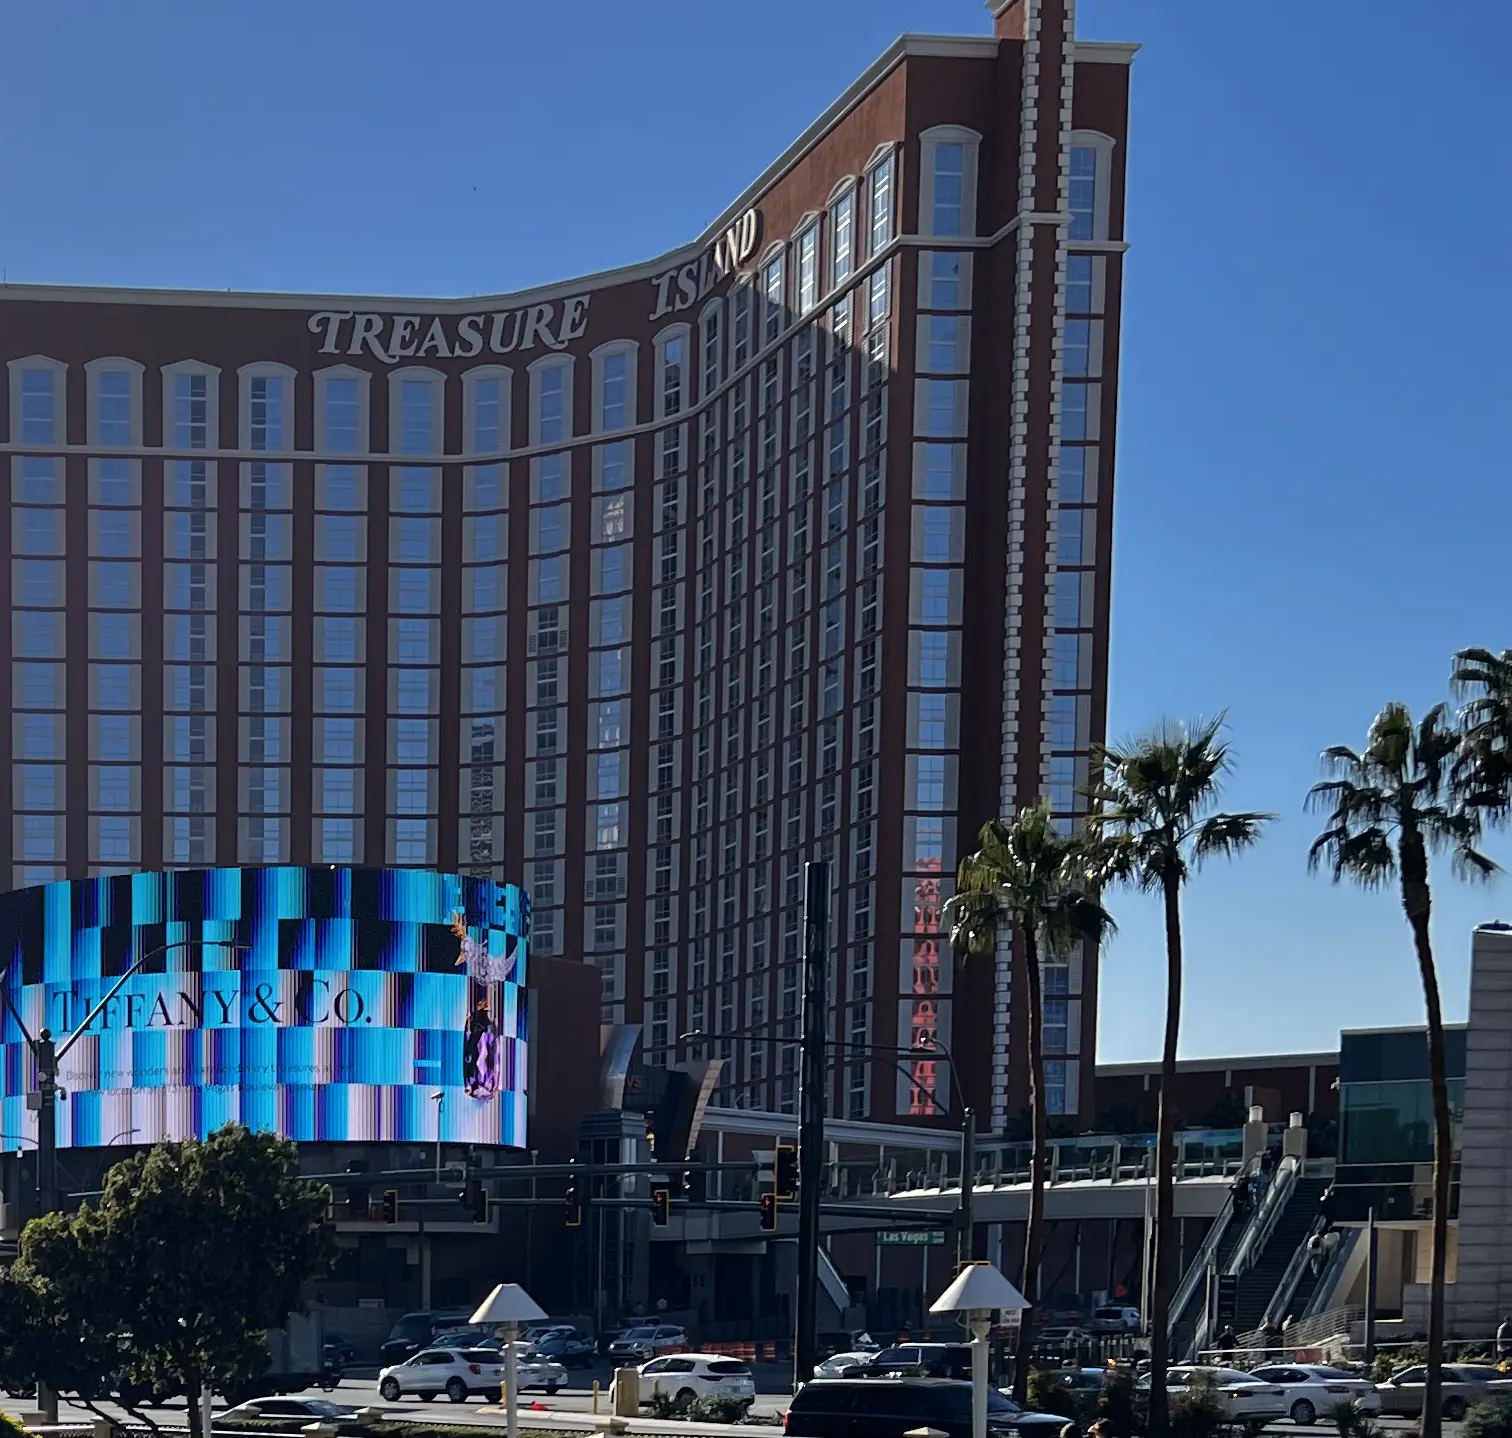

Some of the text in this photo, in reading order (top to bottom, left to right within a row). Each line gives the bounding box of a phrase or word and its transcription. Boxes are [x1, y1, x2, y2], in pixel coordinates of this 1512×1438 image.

[307, 207, 758, 364] TREASURE ISLAND
[53, 989, 240, 1033] TIFFANY
[247, 982, 285, 1024] &
[883, 1231, 899, 1242] Las
[900, 1231, 929, 1244] Vegas
